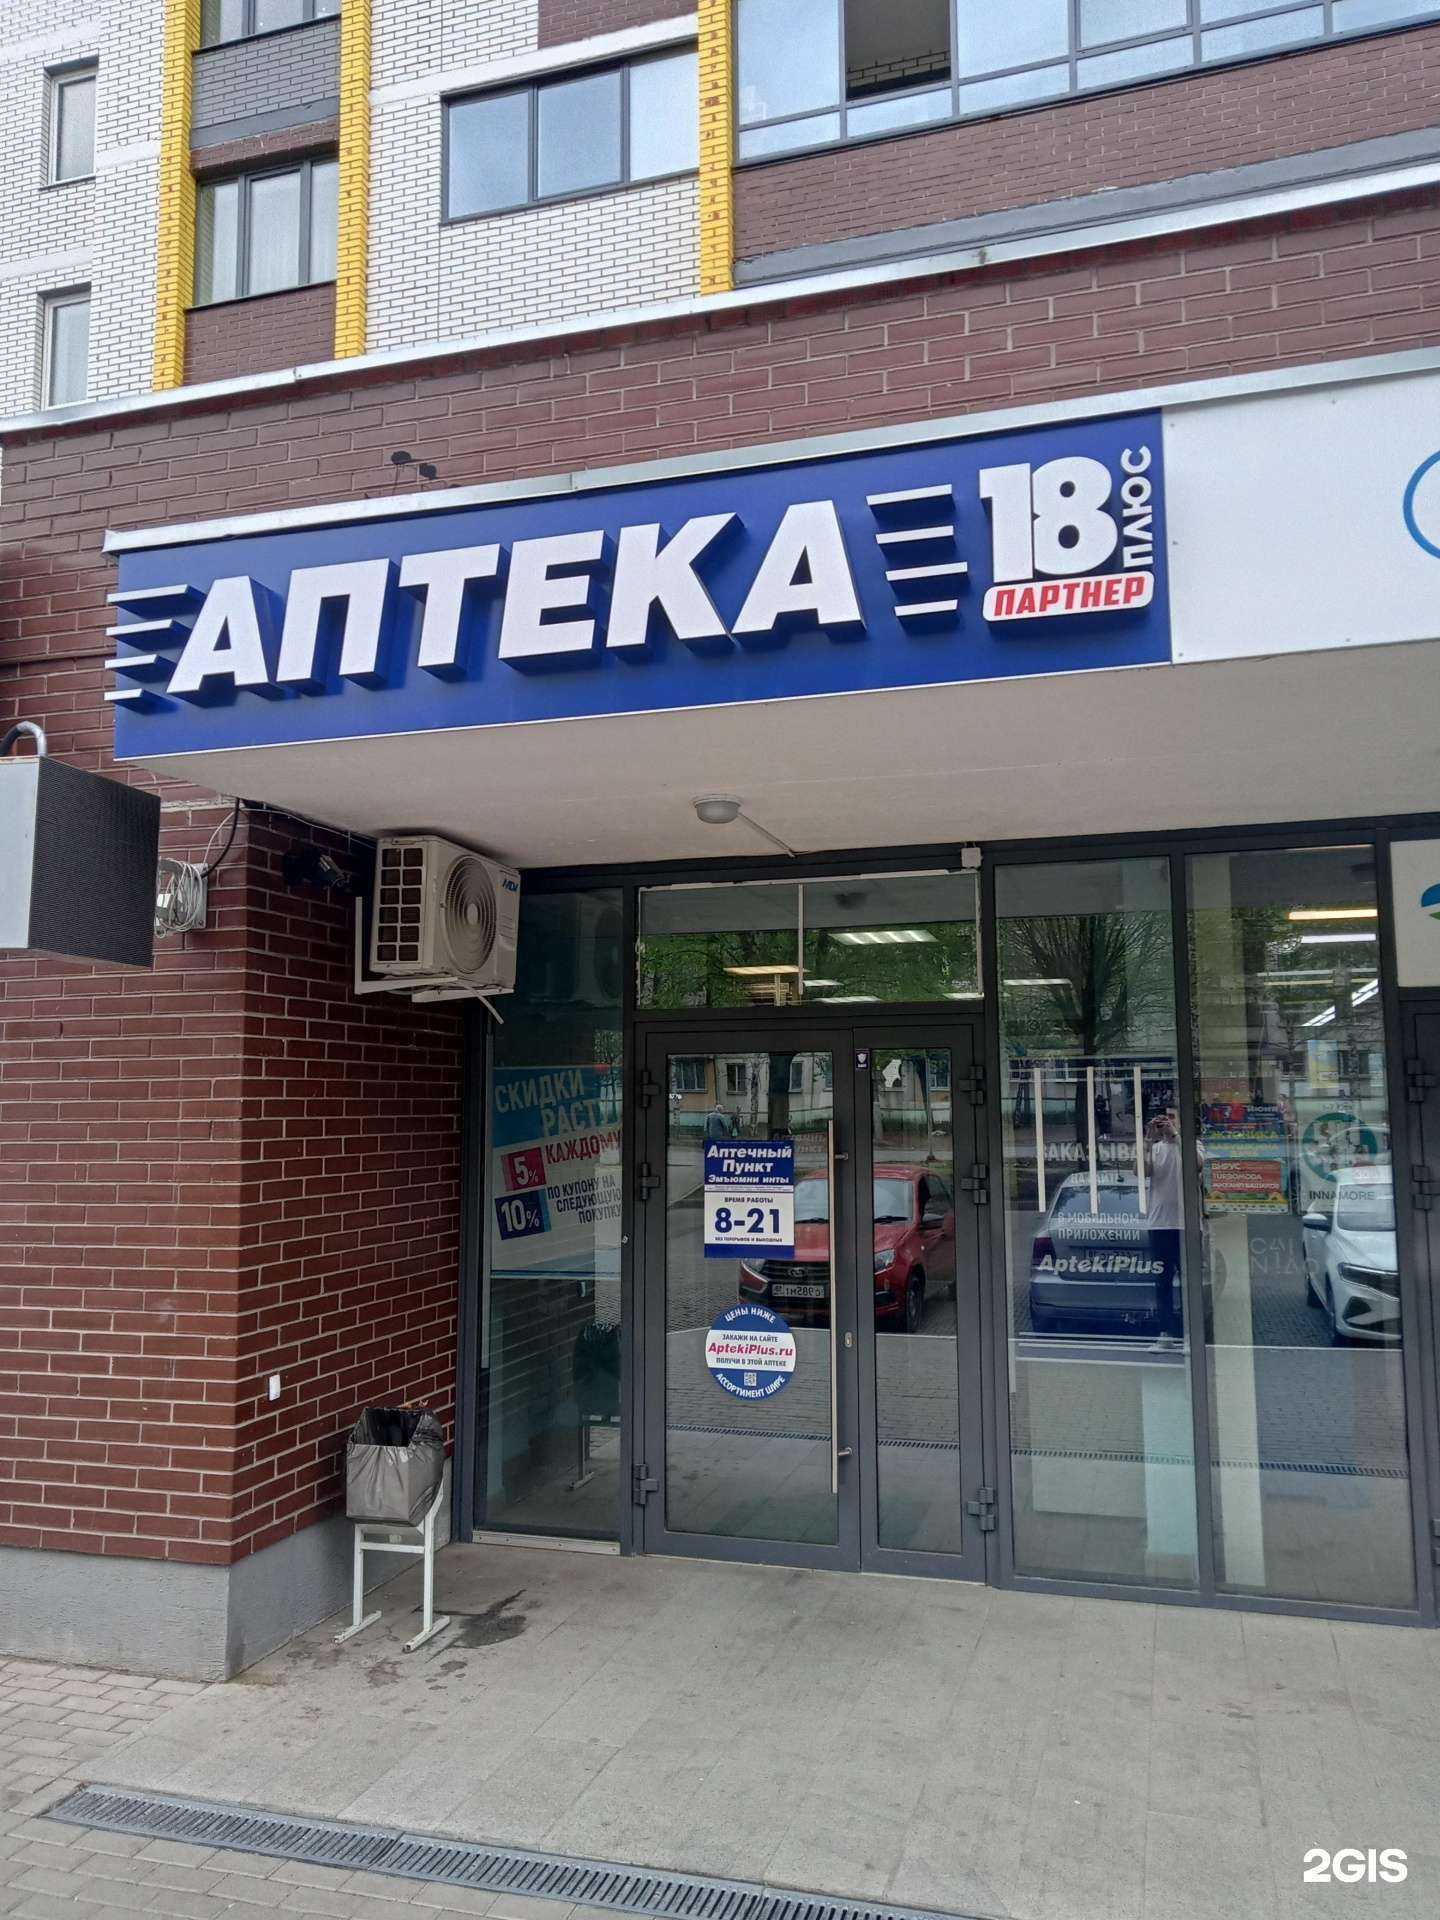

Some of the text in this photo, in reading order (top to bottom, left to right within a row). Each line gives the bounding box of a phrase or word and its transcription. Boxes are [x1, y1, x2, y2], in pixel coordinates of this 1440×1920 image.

[1120, 445, 1154, 567] ПЛЮС
[979, 456, 1118, 583] 18
[166, 500, 862, 694] АПТЕКА
[994, 574, 1146, 616] ПАРТНЕР
[495, 1069, 584, 1113] СКИДКИ
[707, 1145, 792, 1158] Аптечный
[514, 1156, 539, 1185] 5%
[722, 1159, 774, 1174] Пункт
[547, 1186, 560, 1200] ПО
[563, 1177, 599, 1197] КУПОНУ
[1309, 1190, 1375, 1201] INNAMORE
[501, 1199, 540, 1232] 10%
[715, 1207, 780, 1234] 8-21
[1058, 1227, 1140, 1241] ПРИЛОЖЕНИИ
[1038, 1254, 1164, 1275] AptekiPlus
[725, 1307, 776, 1323] ЦЕНЫ НИЖЕ
[708, 1342, 793, 1357] AptekiPlus.ru
[759, 1334, 779, 1342] САЙТЕ
[715, 1372, 786, 1398] АССОРТИМЕНТ ШИРЕ
